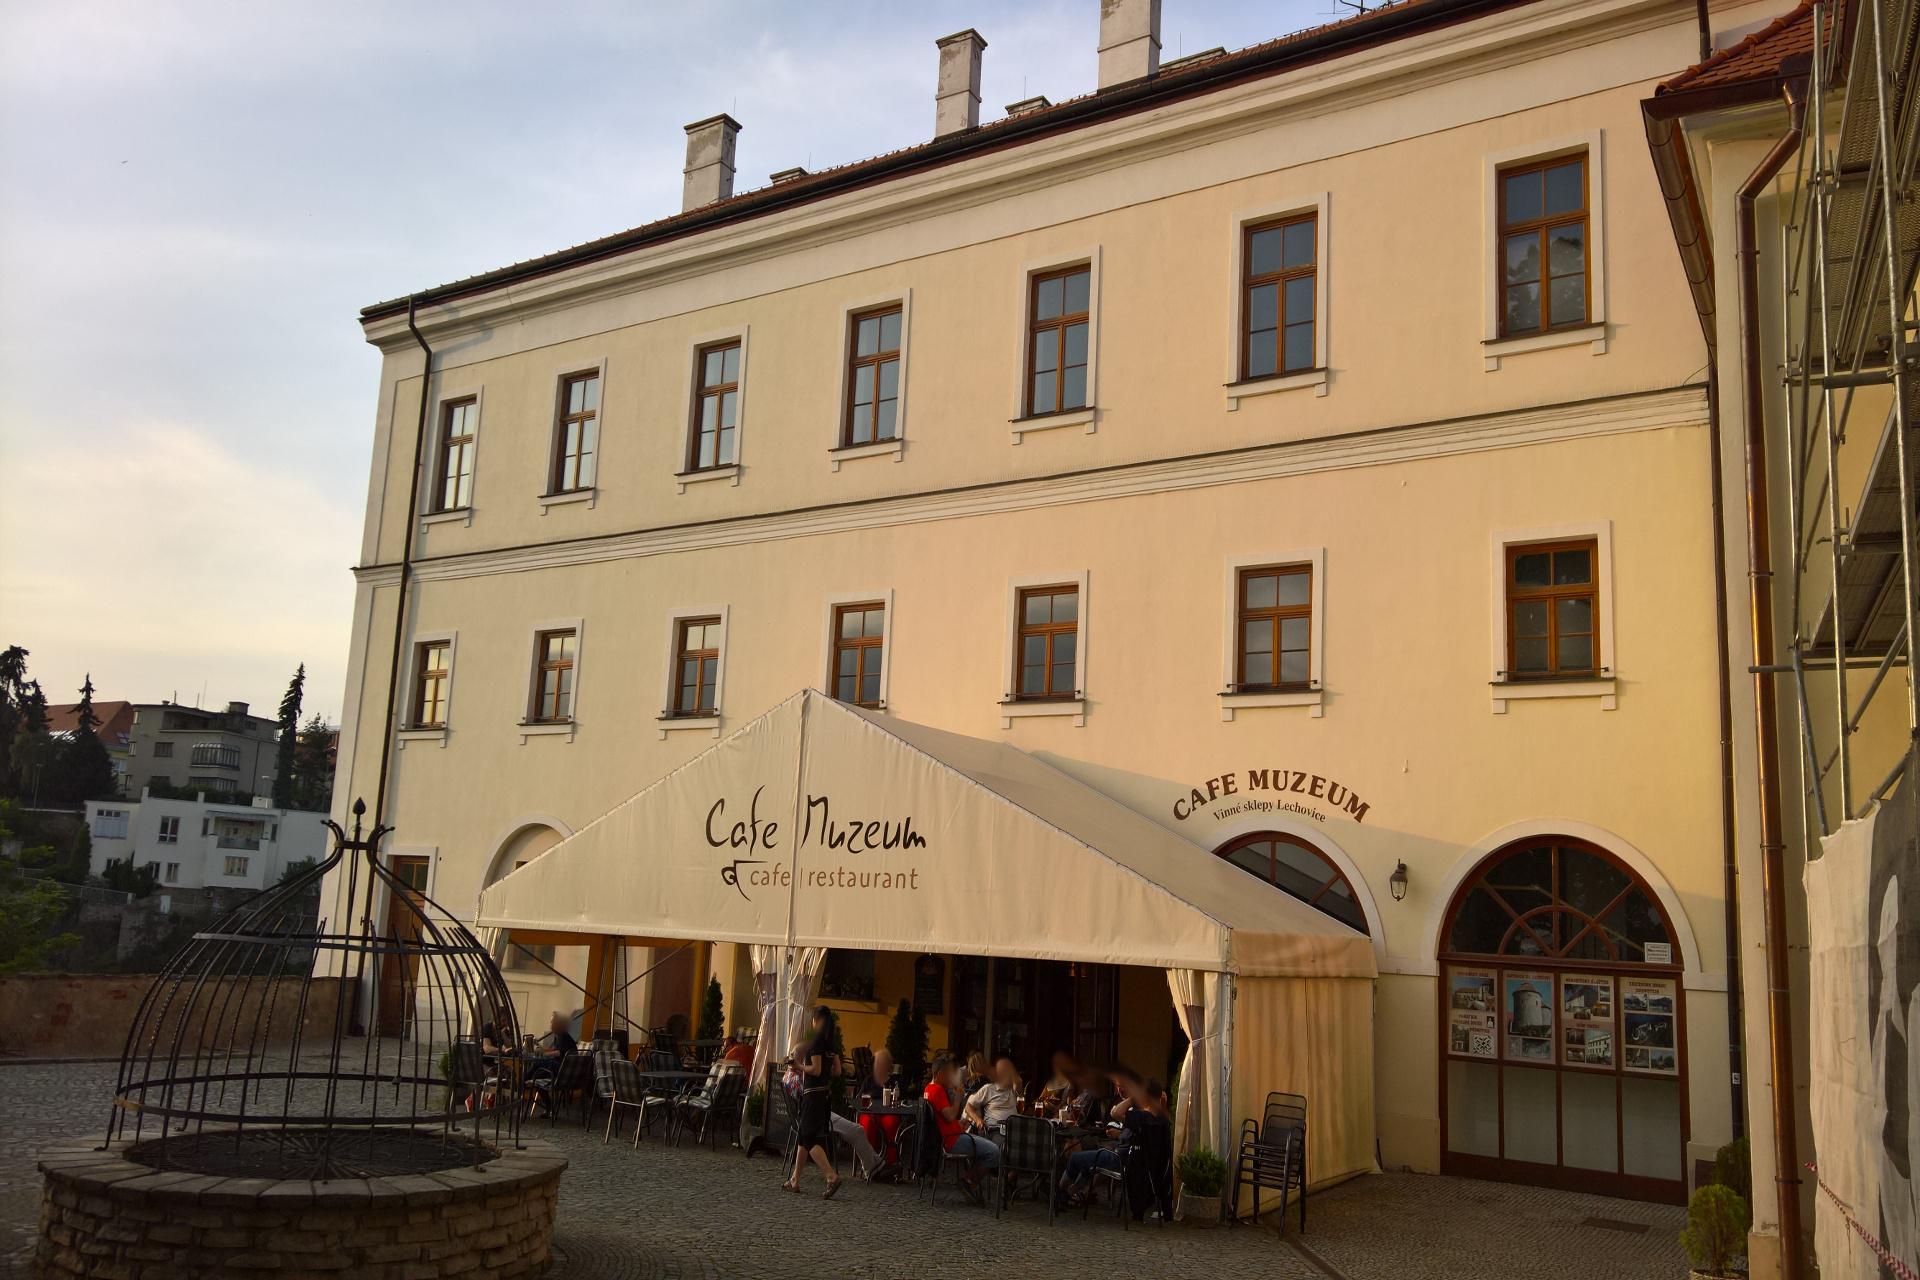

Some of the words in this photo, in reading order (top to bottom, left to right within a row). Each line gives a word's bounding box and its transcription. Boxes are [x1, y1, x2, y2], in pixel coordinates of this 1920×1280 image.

[1173, 772, 1238, 821] CAFE
[1248, 769, 1371, 824] MUZEUM
[1213, 802, 1242, 822] Vinné
[1243, 799, 1275, 813] sklepy
[1277, 799, 1326, 823] Lechovice
[706, 785, 779, 856] Cafe
[801, 795, 927, 854] Muzeum
[750, 862, 791, 887] cafe
[807, 866, 919, 890] restaurant
